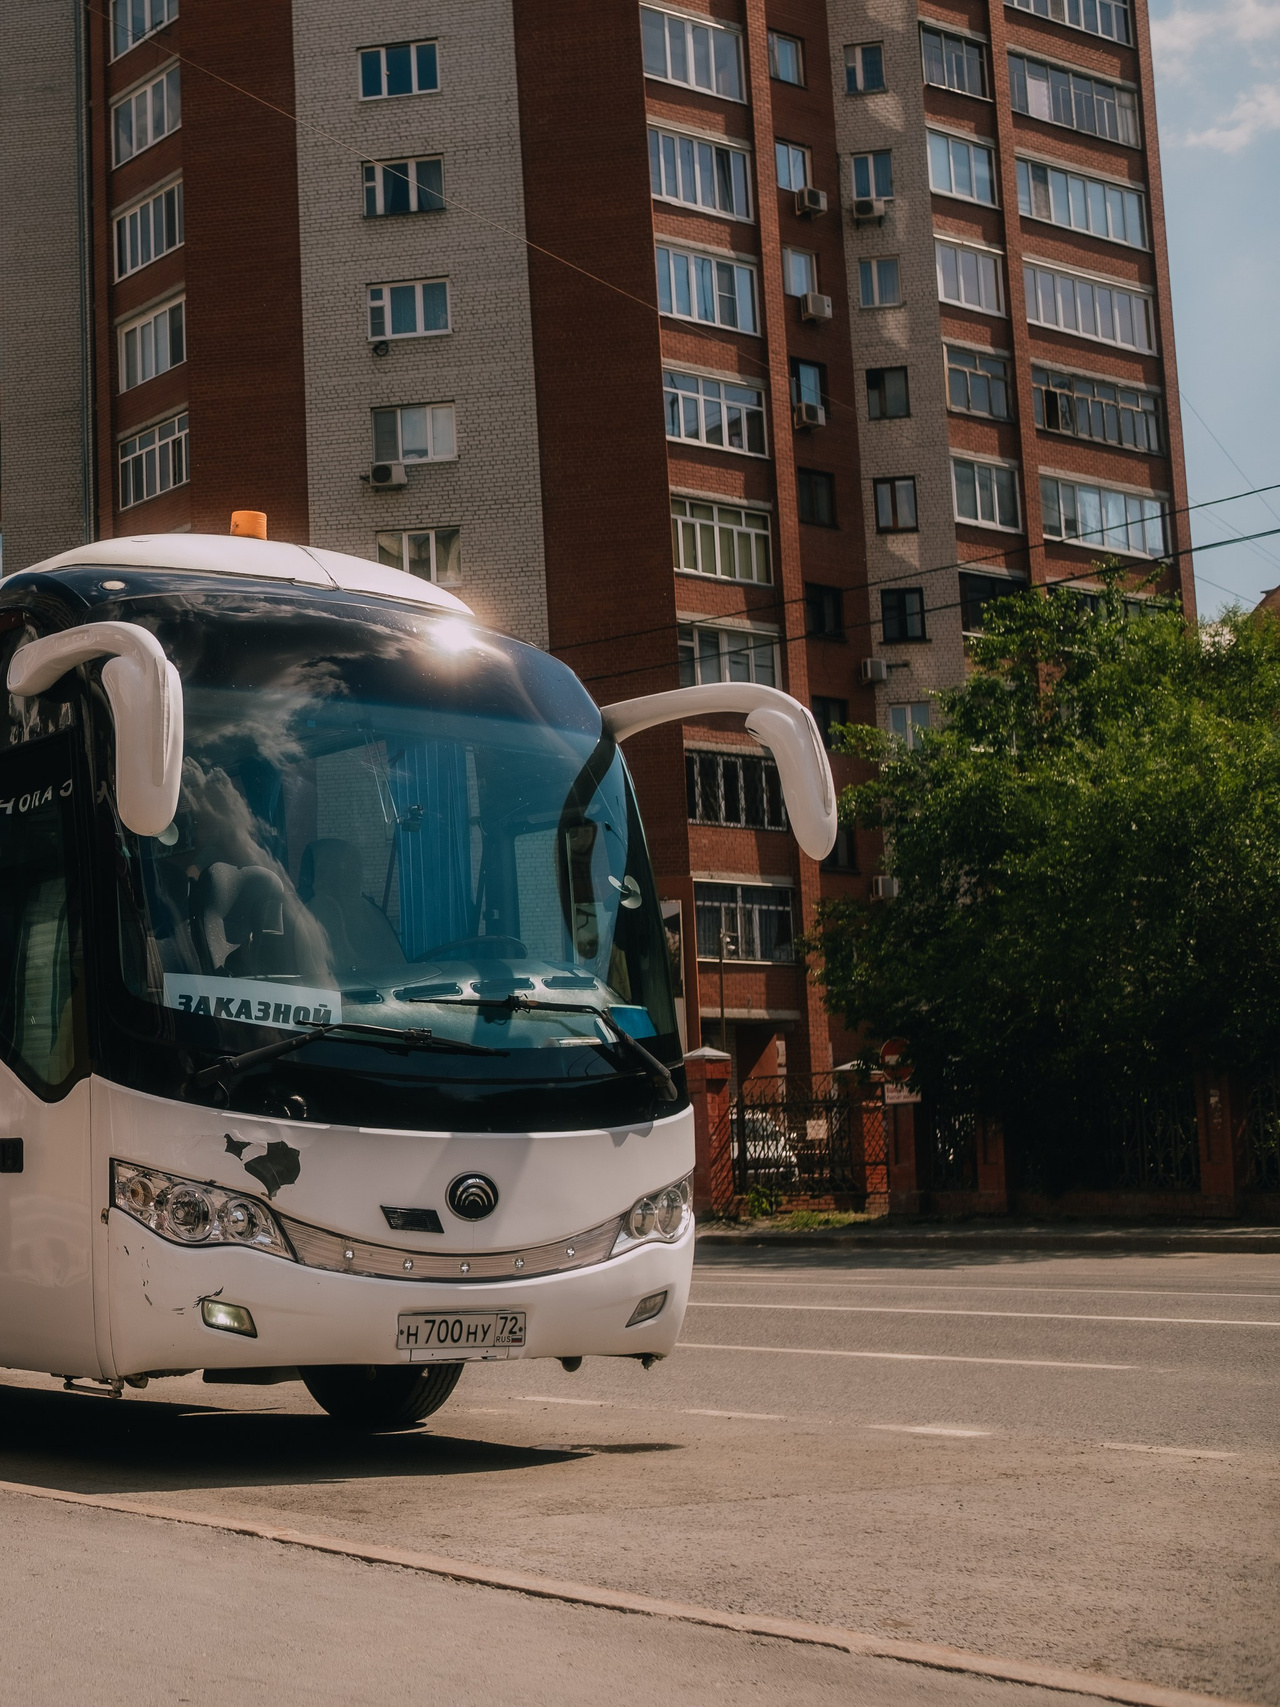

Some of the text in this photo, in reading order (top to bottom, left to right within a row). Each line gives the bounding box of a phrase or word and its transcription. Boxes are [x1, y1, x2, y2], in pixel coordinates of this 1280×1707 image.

[178, 994, 332, 1025] ЗАКАЗНОЙ
[499, 1316, 518, 1335] 72
[495, 1335, 511, 1343] RUS
